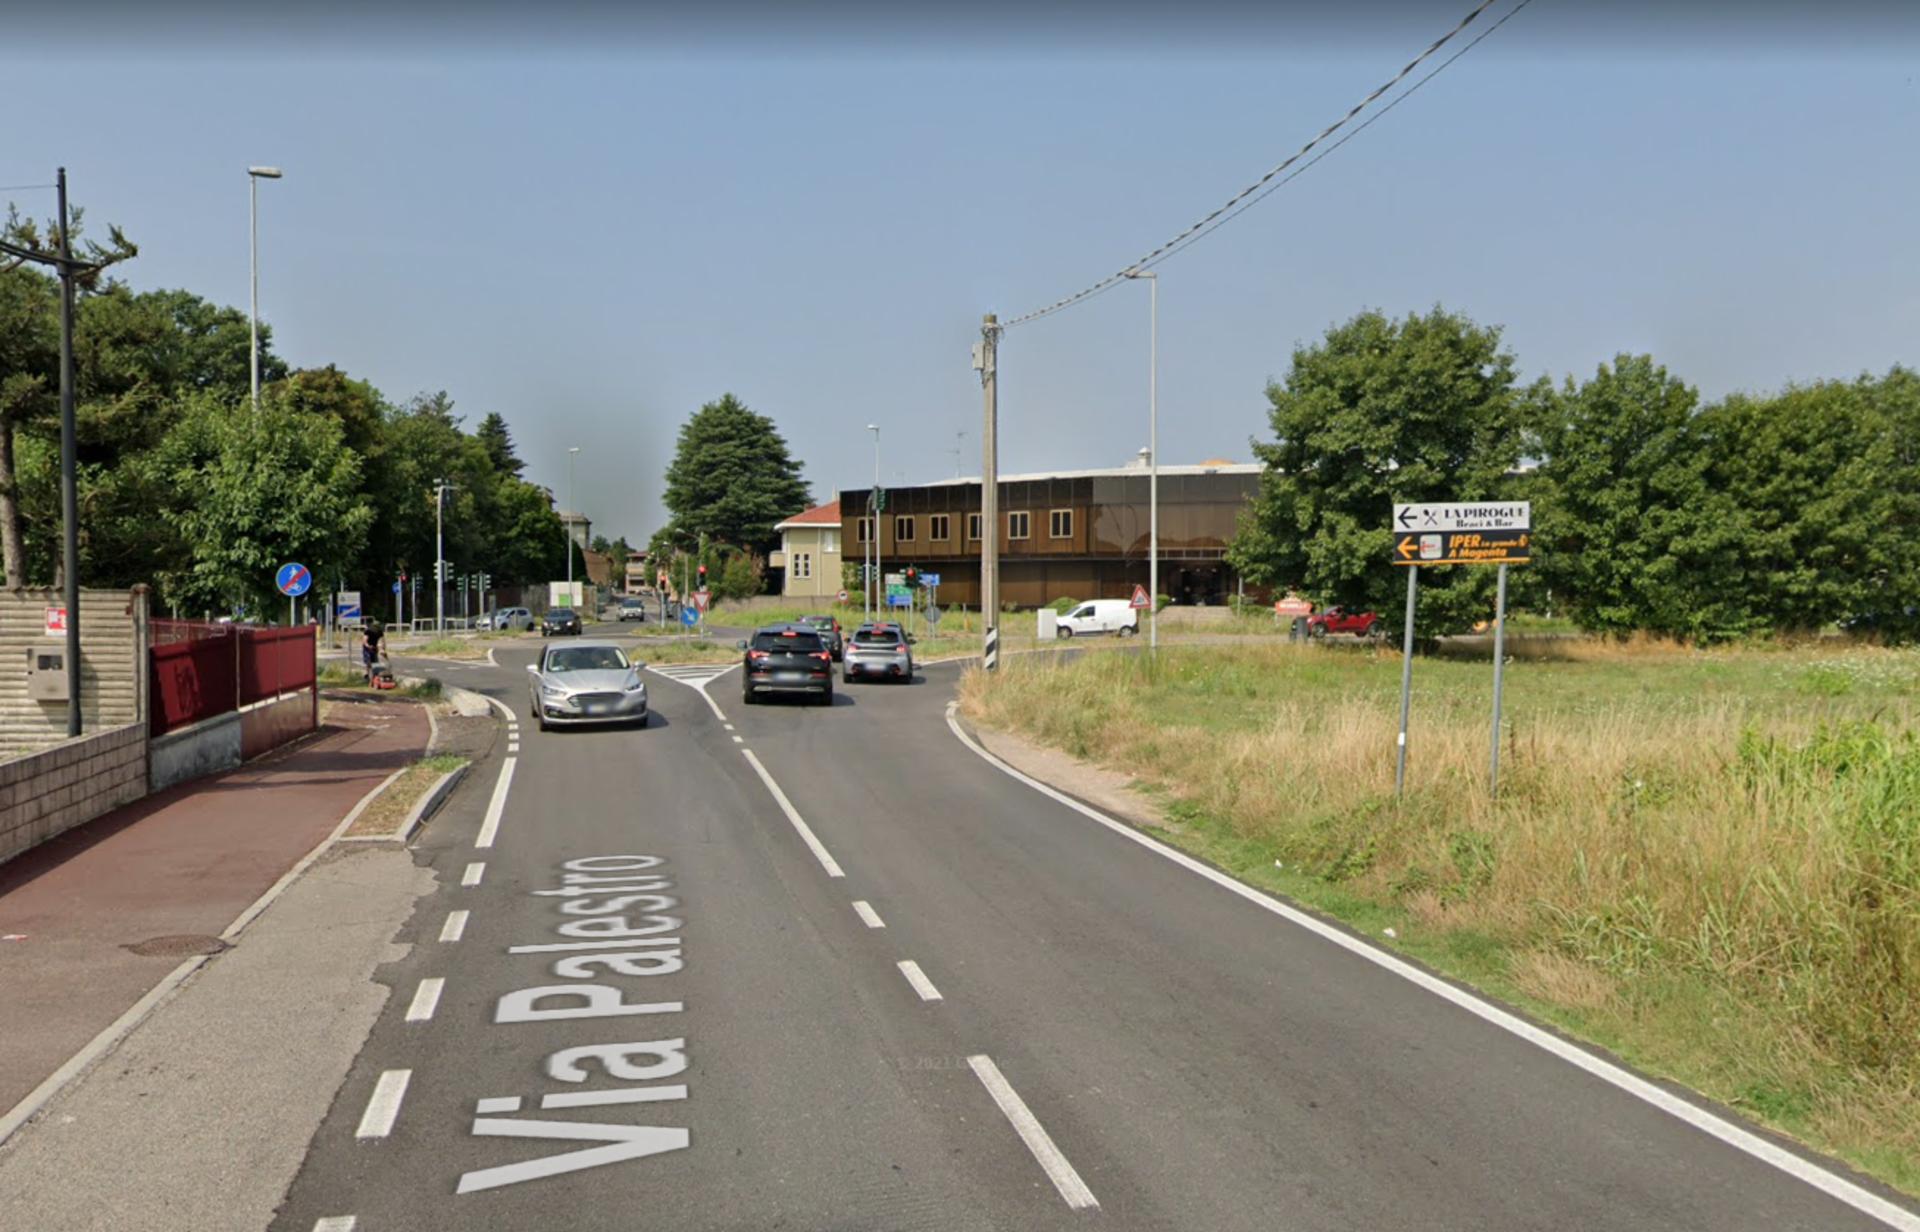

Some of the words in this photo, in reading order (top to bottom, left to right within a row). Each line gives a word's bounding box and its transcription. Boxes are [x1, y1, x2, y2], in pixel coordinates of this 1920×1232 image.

[1449, 534, 1482, 548] IPER
[1459, 548, 1508, 559] Magenta
[495, 855, 684, 1023] Palestro
[456, 1037, 689, 1194] Via
